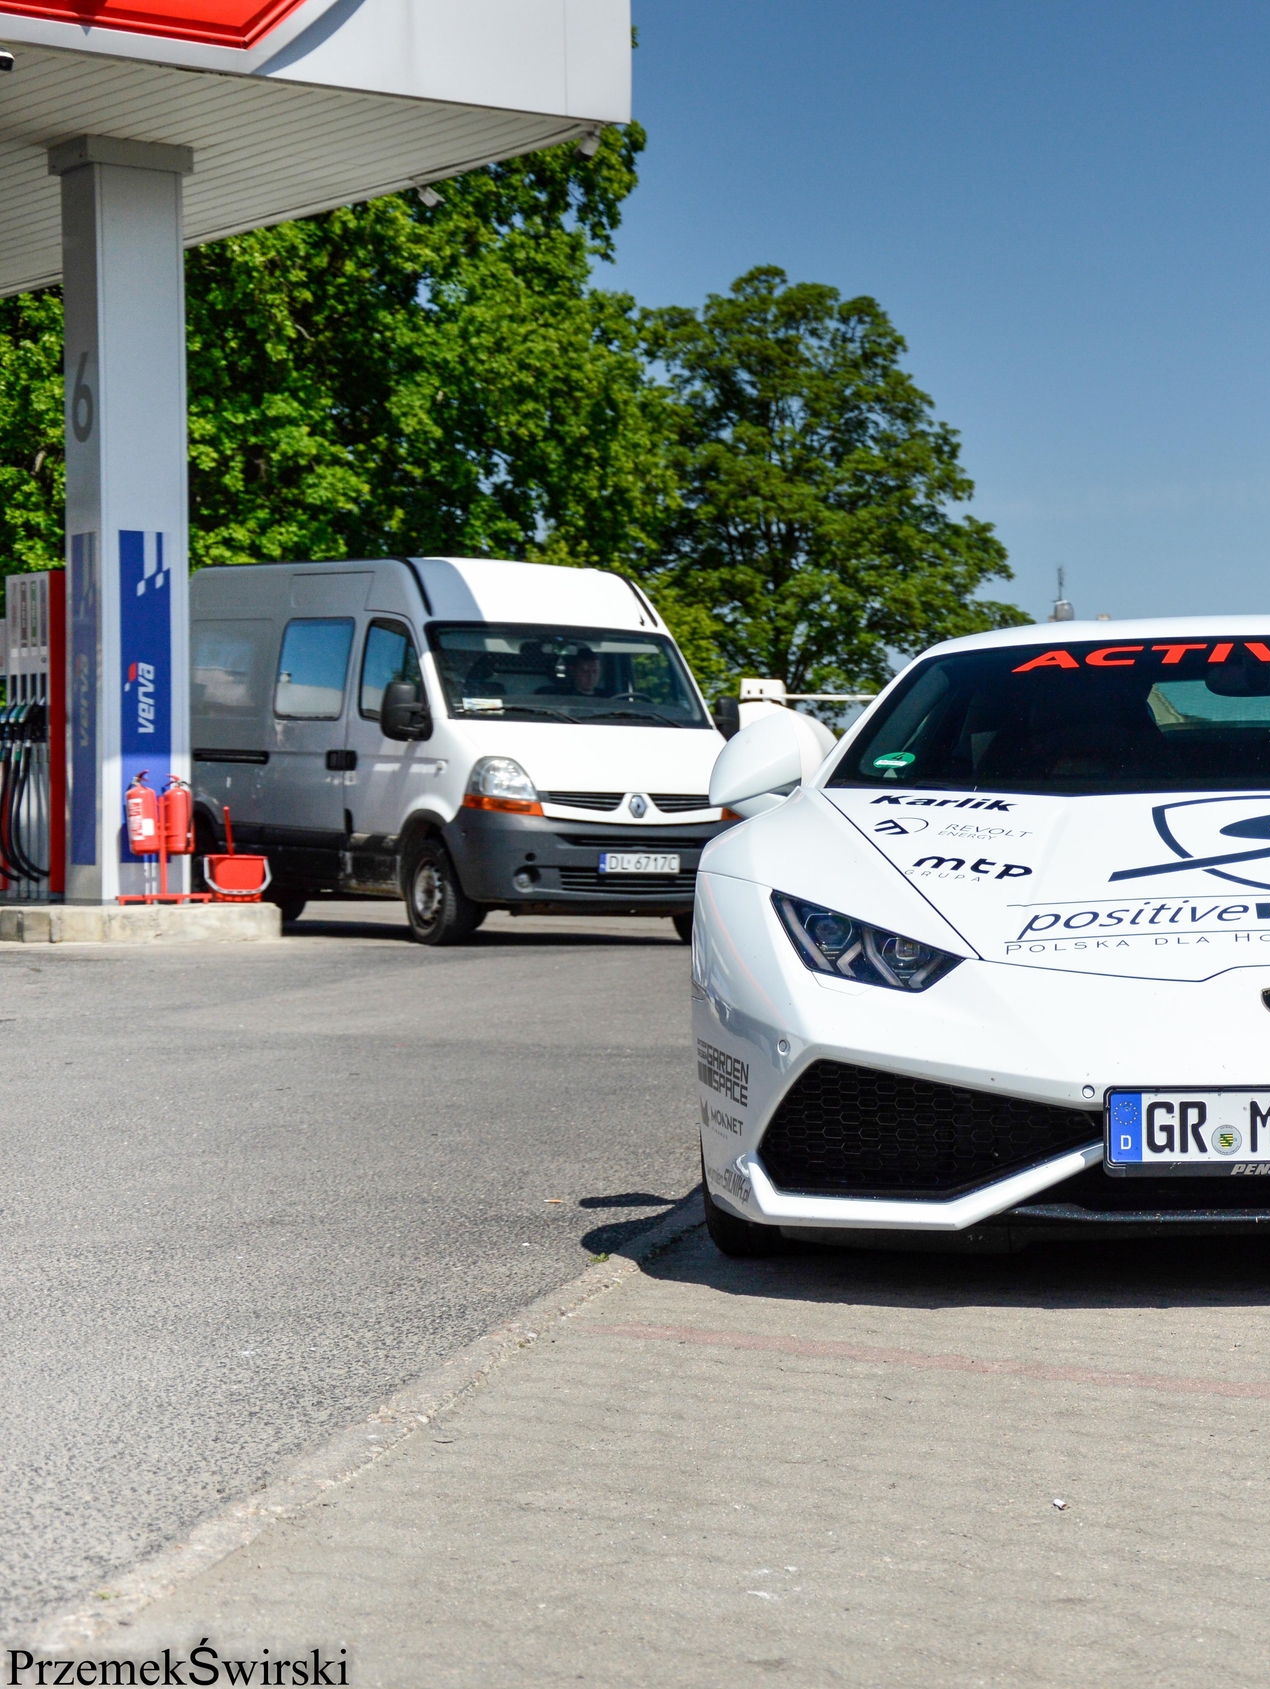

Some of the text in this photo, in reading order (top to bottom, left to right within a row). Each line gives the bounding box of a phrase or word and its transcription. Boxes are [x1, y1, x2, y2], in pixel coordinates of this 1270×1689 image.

[72, 352, 94, 443] 6
[138, 662, 154, 733] verva
[869, 795, 1019, 811] Karlik
[938, 831, 997, 840] ENERGY
[945, 824, 1033, 838] REVOLT
[608, 856, 677, 870] DL 6717C
[912, 856, 1032, 879] mtp
[904, 870, 981, 882] GRUPA
[1006, 940, 1130, 955] POLSKA
[1155, 936, 1210, 945] DLA
[707, 1044, 749, 1085] GARDEN
[713, 1070, 748, 1108] SPACE
[1146, 1101, 1208, 1153] GR
[1120, 1135, 1132, 1150] D
